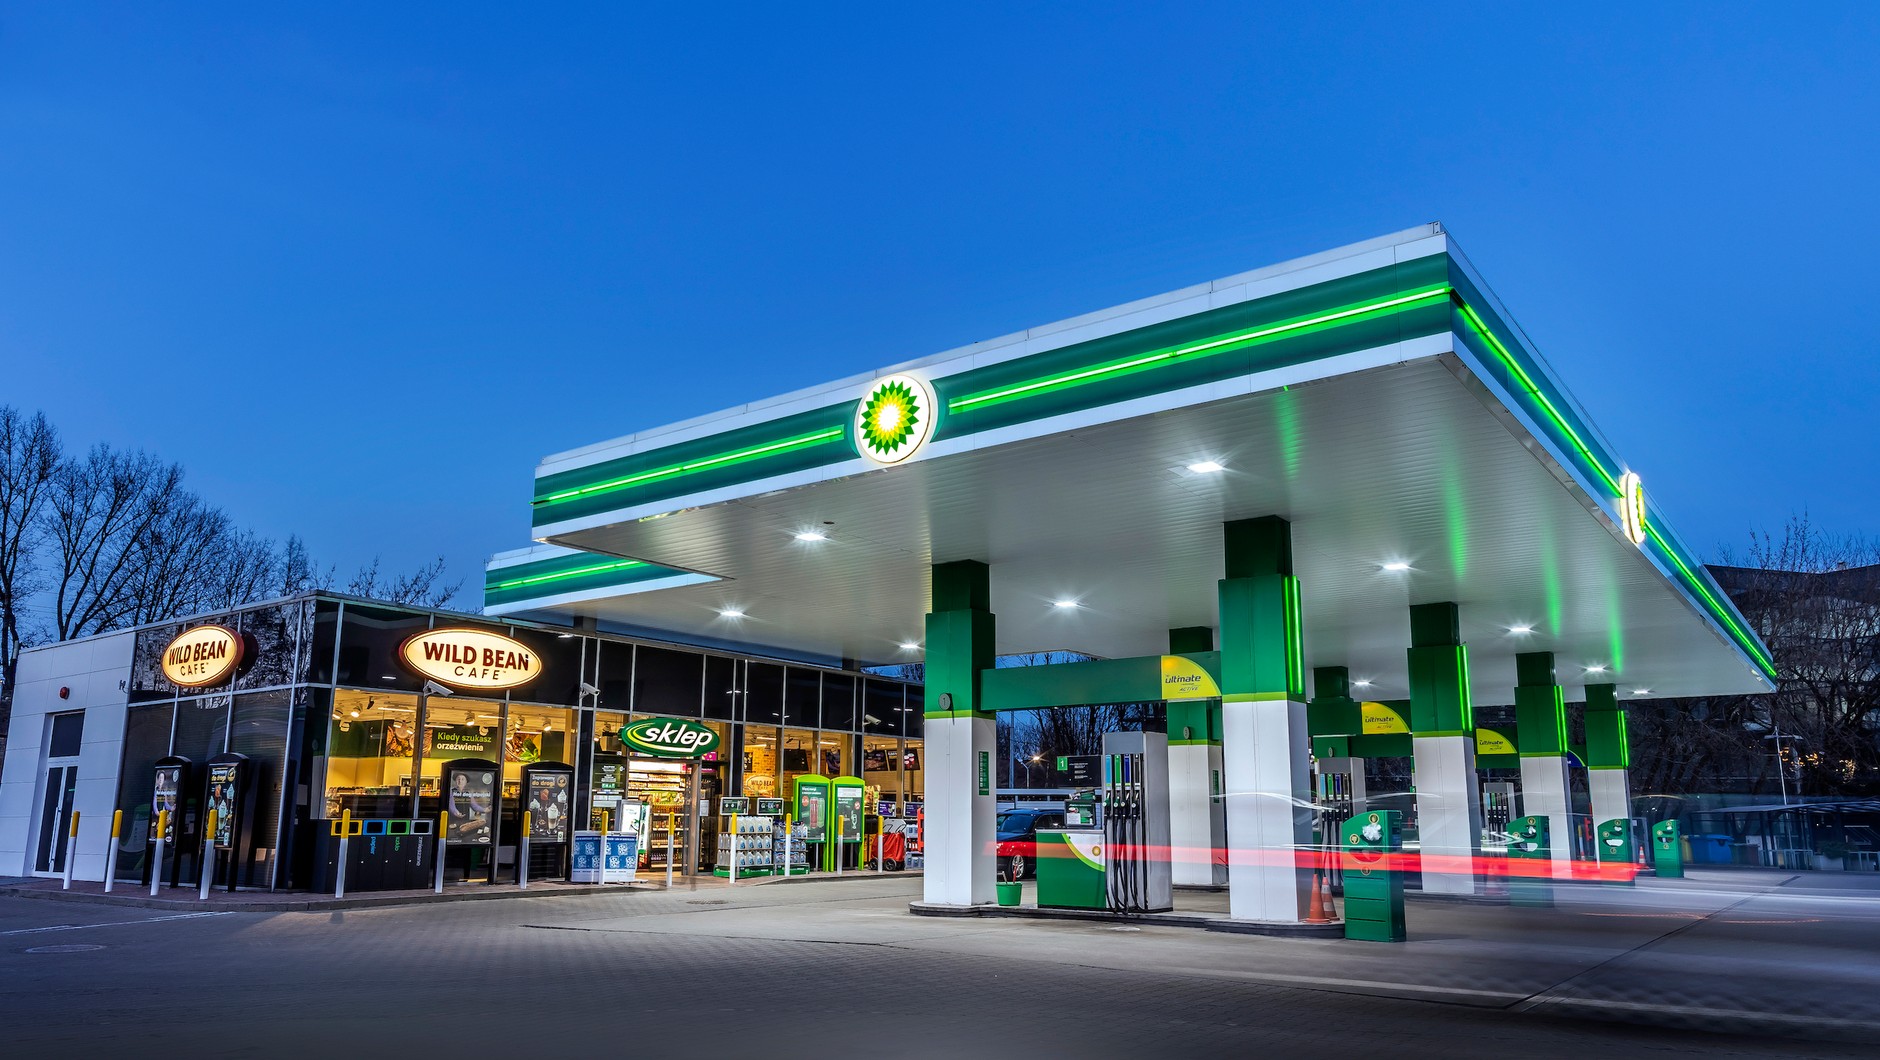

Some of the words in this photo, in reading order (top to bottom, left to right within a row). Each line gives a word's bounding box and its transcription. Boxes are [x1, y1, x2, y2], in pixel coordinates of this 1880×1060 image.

[168, 644, 192, 666] WILD
[193, 639, 228, 662] BEAN
[423, 641, 478, 665] WILD
[482, 648, 529, 671] BEAN
[180, 662, 206, 676] CAFE
[454, 665, 500, 680] CAFE
[1165, 674, 1201, 684] ultimate
[437, 732, 460, 743] Kiedy
[461, 734, 492, 743] szukasz
[645, 722, 713, 753] sklep
[436, 742, 484, 752] orzeźwienia
[369, 836, 377, 855] papier
